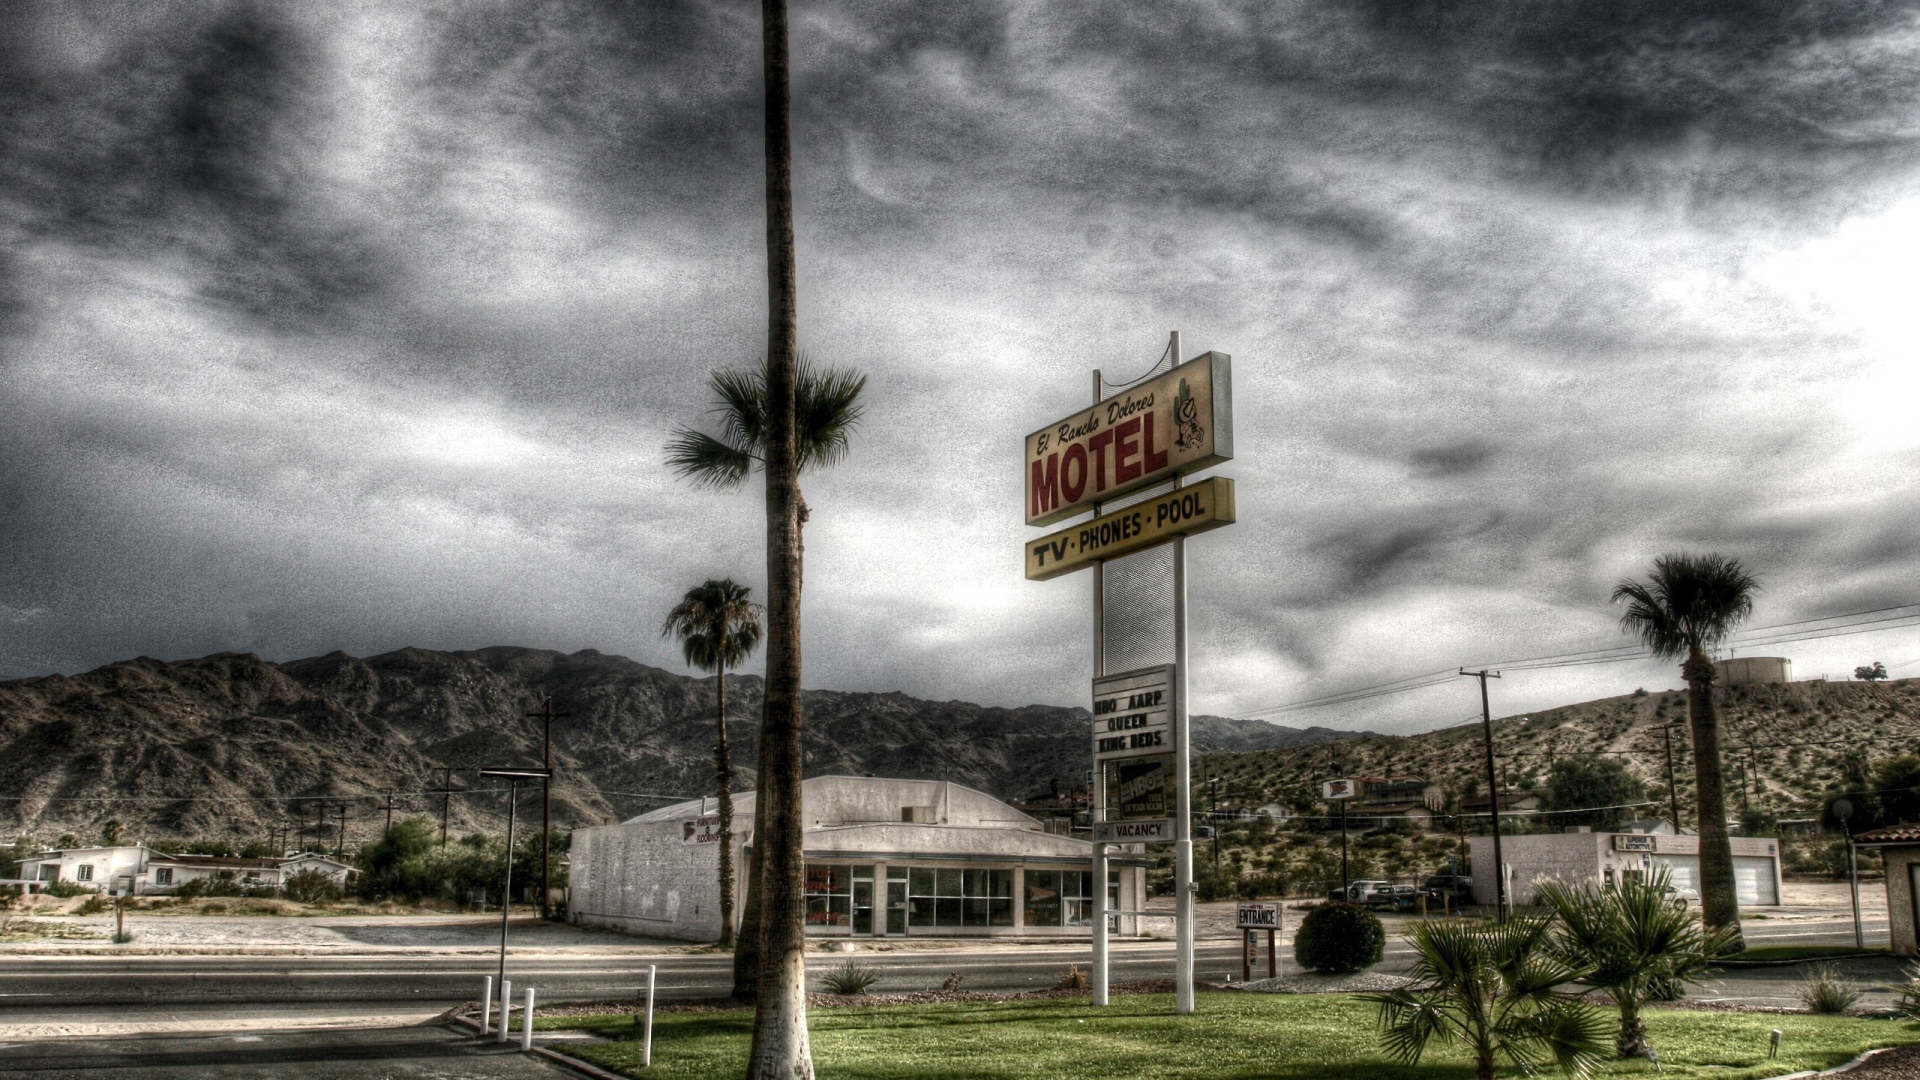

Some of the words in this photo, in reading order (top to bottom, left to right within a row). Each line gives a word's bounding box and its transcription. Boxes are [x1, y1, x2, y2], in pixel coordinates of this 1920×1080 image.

[1036, 433, 1050, 456] El
[1058, 411, 1099, 446] Rancho
[1107, 392, 1155, 425] Dolores
[1032, 411, 1168, 517] MOTEL
[1034, 537, 1069, 567] TV
[1079, 512, 1141, 553] PHONES
[1157, 492, 1205, 528] POOL
[1095, 698, 1117, 715] HBO
[1128, 690, 1162, 710] AARP
[1108, 713, 1147, 732] QUEEN
[1099, 735, 1126, 752] KING
[1130, 730, 1162, 749] BEDS
[1130, 771, 1157, 798] HBO
[1116, 823, 1162, 837] VACANCY
[1239, 909, 1275, 925] ENTRANCE
